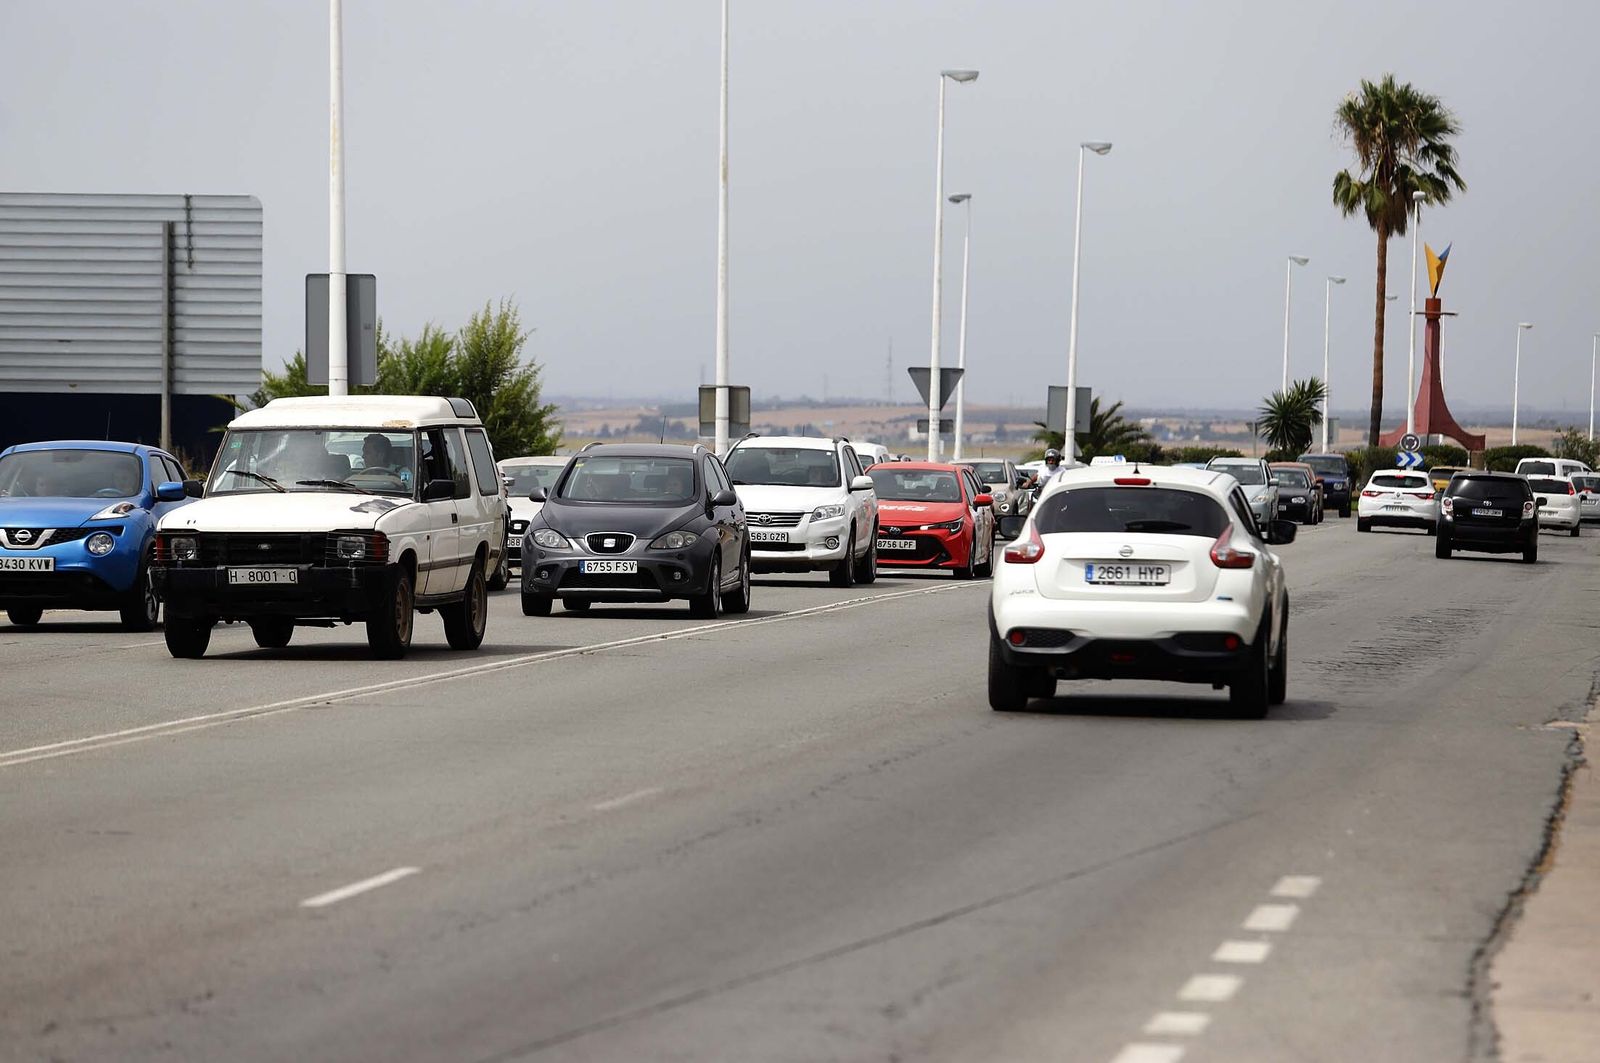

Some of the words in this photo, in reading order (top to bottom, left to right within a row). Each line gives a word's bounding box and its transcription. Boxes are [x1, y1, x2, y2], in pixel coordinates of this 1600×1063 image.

[769, 532, 786, 541] GZR
[877, 540, 897, 548] 8756
[586, 562, 612, 572] 6755
[615, 562, 635, 572] FSV
[1098, 566, 1131, 580] 2661
[1138, 566, 1165, 580] HYP
